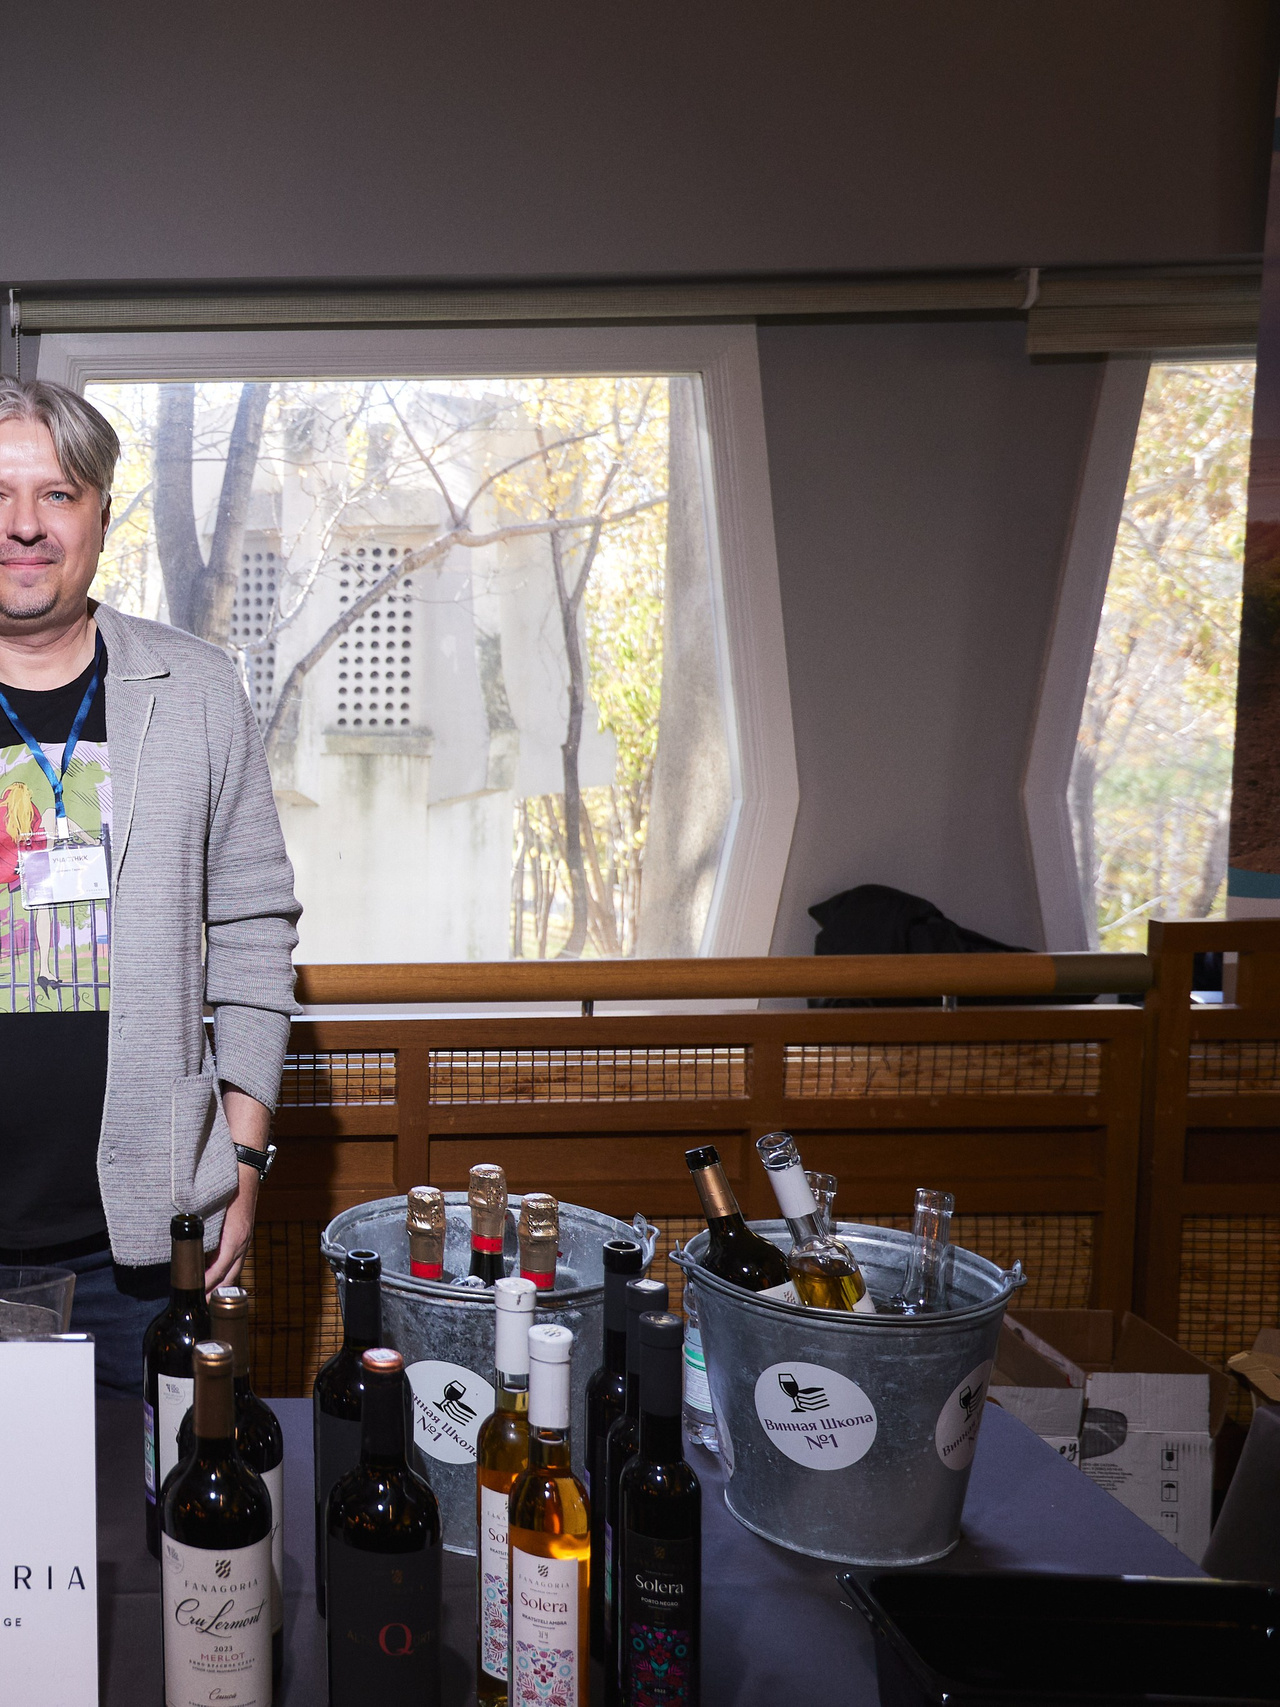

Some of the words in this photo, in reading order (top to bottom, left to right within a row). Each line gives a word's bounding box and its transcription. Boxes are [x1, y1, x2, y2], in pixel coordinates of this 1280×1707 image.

[416, 1415, 443, 1442] №1
[763, 1418, 818, 1432] Винная
[819, 1413, 874, 1431] Школа
[803, 1433, 839, 1451] №1
[184, 1578, 258, 1593] FANAGORIA
[635, 1573, 684, 1595] Solera
[520, 1592, 568, 1613] Solera
[174, 1598, 206, 1627] Cru
[195, 1598, 268, 1639] Lermont
[200, 1651, 246, 1662] MERLOT
[213, 1645, 234, 1653] 2023
